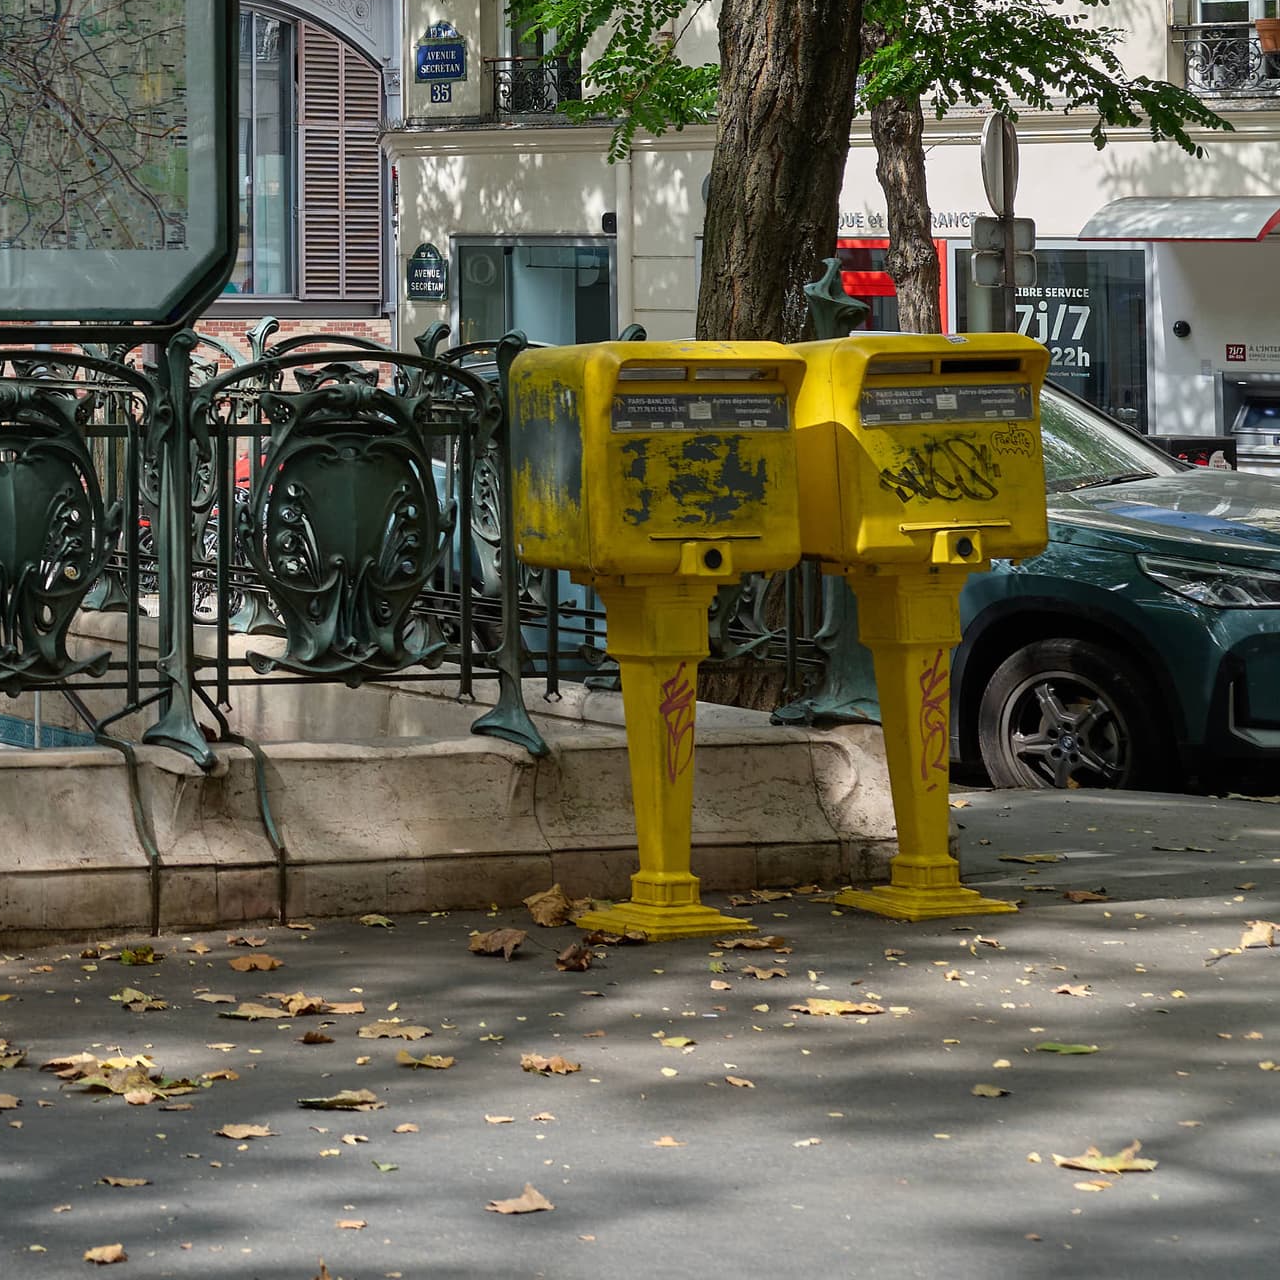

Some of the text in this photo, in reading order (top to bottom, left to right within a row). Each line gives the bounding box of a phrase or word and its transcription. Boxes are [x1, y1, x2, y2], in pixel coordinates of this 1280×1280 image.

[426, 50, 457, 61] AVENUE
[433, 84, 450, 102] 35
[867, 212, 885, 228] et
[414, 269, 441, 278] AVENUE
[410, 280, 444, 291] SECRÉTAN
[1014, 287, 1090, 298] IBRE SERVICE
[1015, 300, 1091, 345] 7j/7
